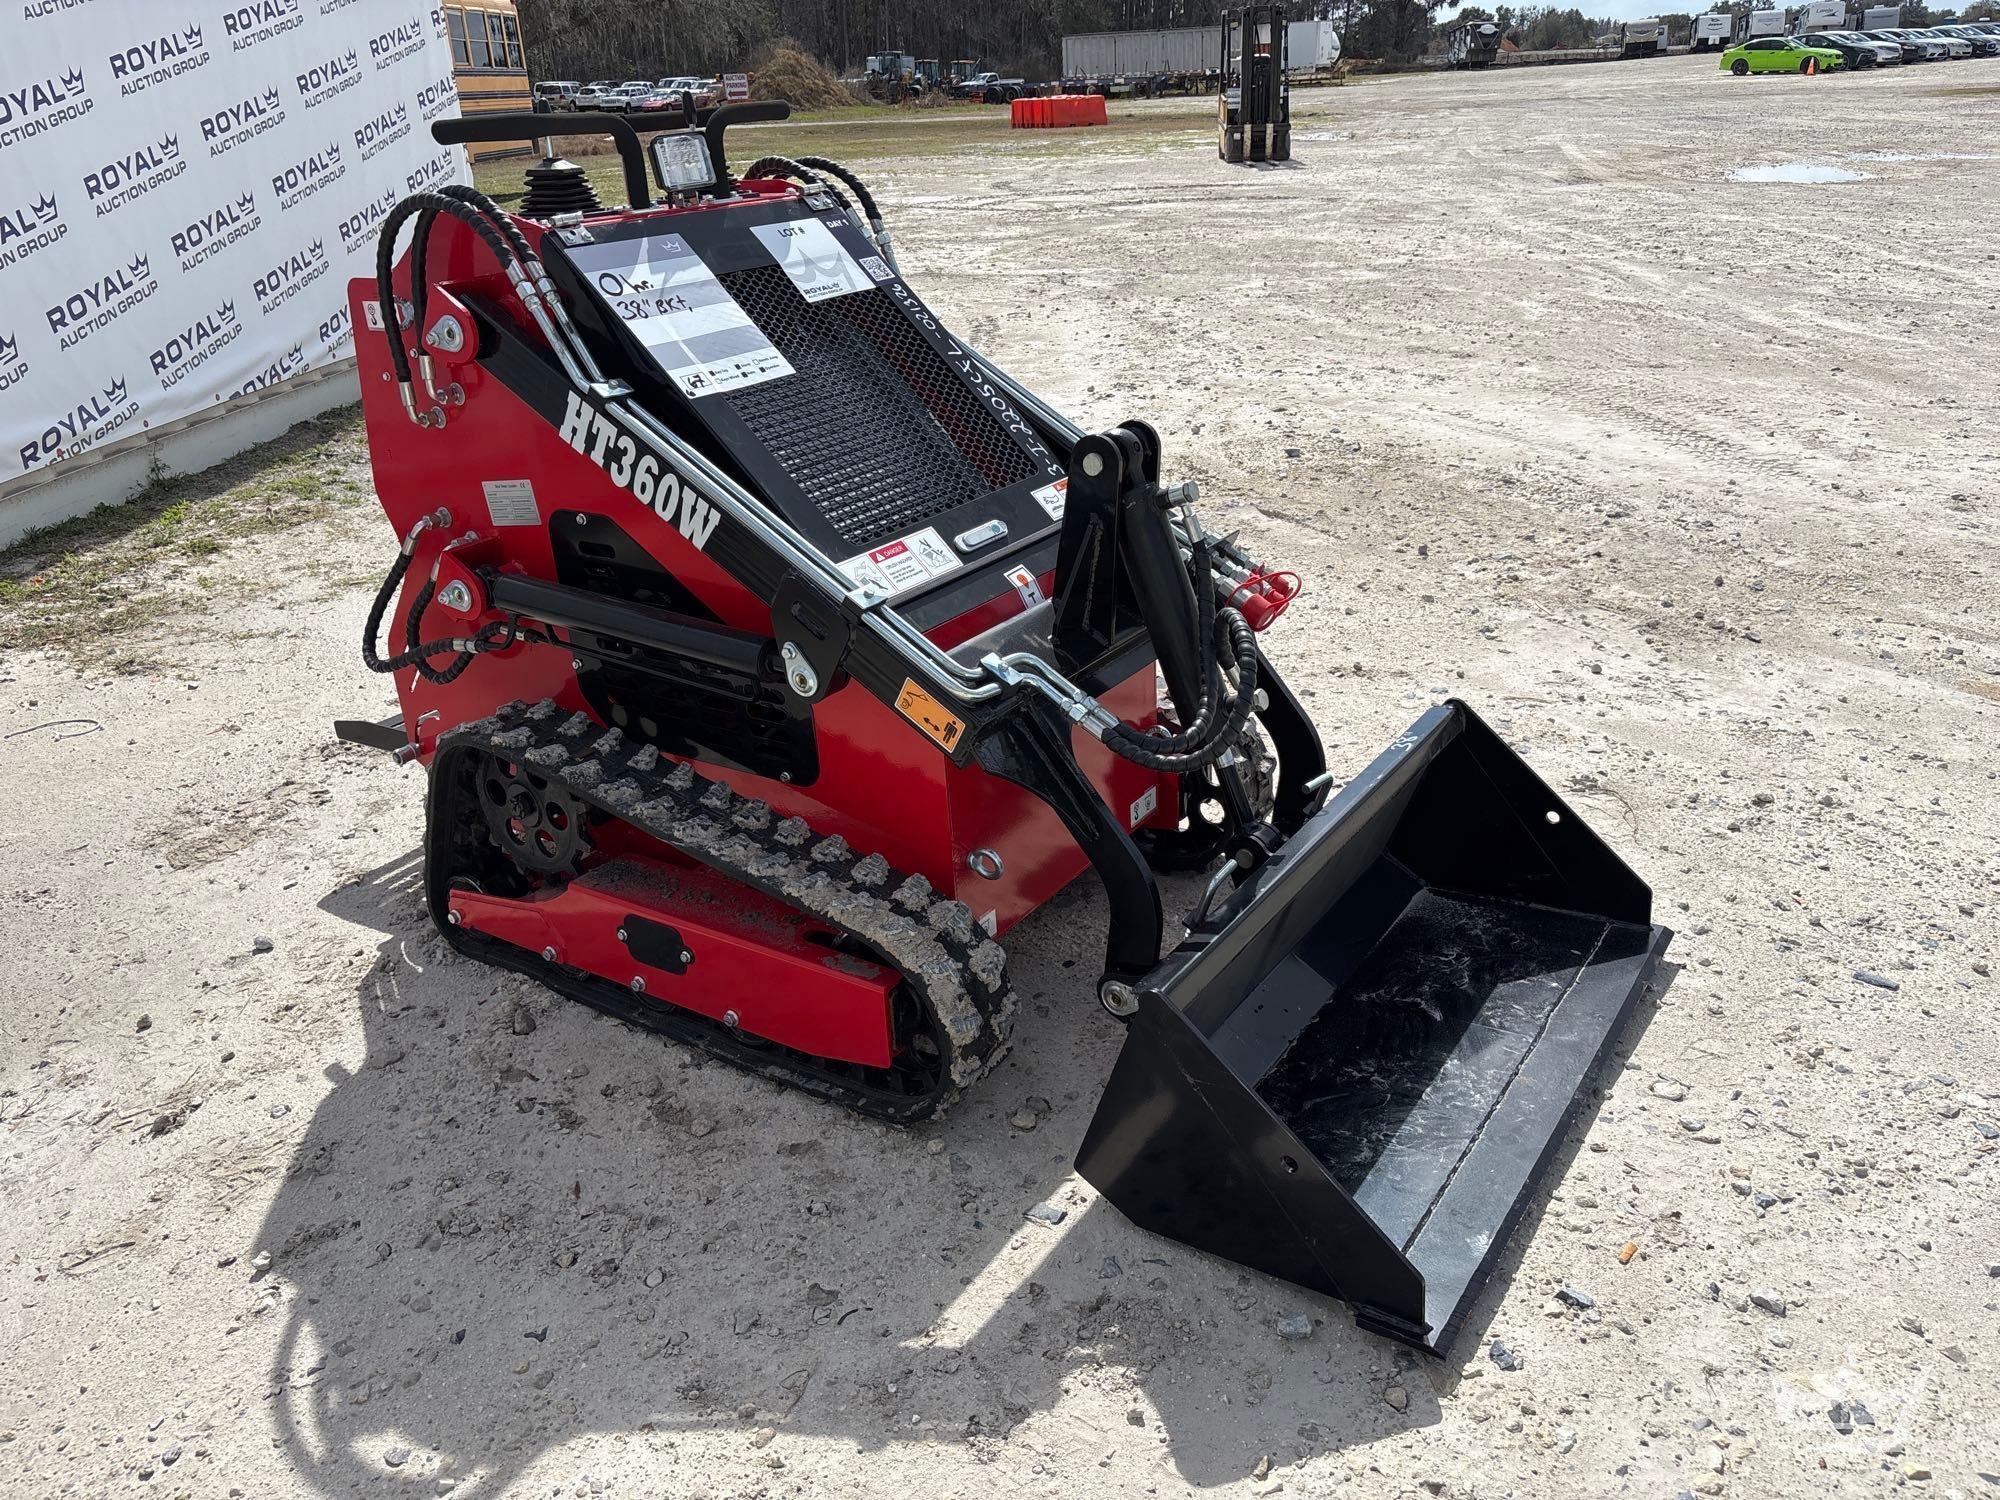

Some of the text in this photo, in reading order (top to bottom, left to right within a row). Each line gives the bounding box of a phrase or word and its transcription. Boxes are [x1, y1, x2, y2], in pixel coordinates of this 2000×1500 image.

[223, 0, 286, 35] ROYAL
[232, 14, 304, 52] AUCTION GROUP
[109, 33, 188, 79] ROYAL
[369, 24, 412, 58] ROYAL
[376, 39, 426, 72] AUCTION GROUP
[120, 51, 210, 97] AUCTION GROUP
[297, 57, 348, 95] ROYAL
[304, 72, 363, 110] AUCTION GROUP
[417, 76, 453, 109] ROYAL
[48, 98, 94, 127] GROUP
[200, 96, 267, 141] ROYAL
[354, 111, 397, 149] ROYAL
[422, 100, 447, 122] AUCTION
[210, 111, 286, 158] AUCTION GROUP
[361, 123, 411, 163] AUCTION GROUP
[83, 146, 163, 200] ROYAL
[96, 160, 187, 218] AUCTION GROUP
[272, 153, 329, 198] ROYAL
[281, 165, 346, 212] AUCTION GROUP
[407, 156, 444, 193] ROYAL
[16, 223, 68, 258] GROUP
[171, 204, 240, 257] ROYAL
[339, 199, 386, 242] ROYAL
[777, 227, 799, 238] LOT
[826, 220, 843, 228] DAY
[181, 216, 262, 273] AUCTION GROUP
[347, 226, 378, 256] AUCTION
[253, 251, 312, 301] ROYAL
[262, 260, 330, 316] AUCTION GROUP
[803, 283, 831, 295] ROYAL
[46, 269, 133, 334] ROYAL
[60, 280, 158, 352] AUCTION GROUP
[616, 299, 650, 320] 38"
[150, 314, 222, 375] ROYAL
[161, 322, 243, 391] AUCTION GROUP
[20, 396, 111, 470] ROYAL
[94, 401, 140, 440] GROUP
[558, 389, 722, 552] HT360W
[884, 545, 906, 557] DANGER
